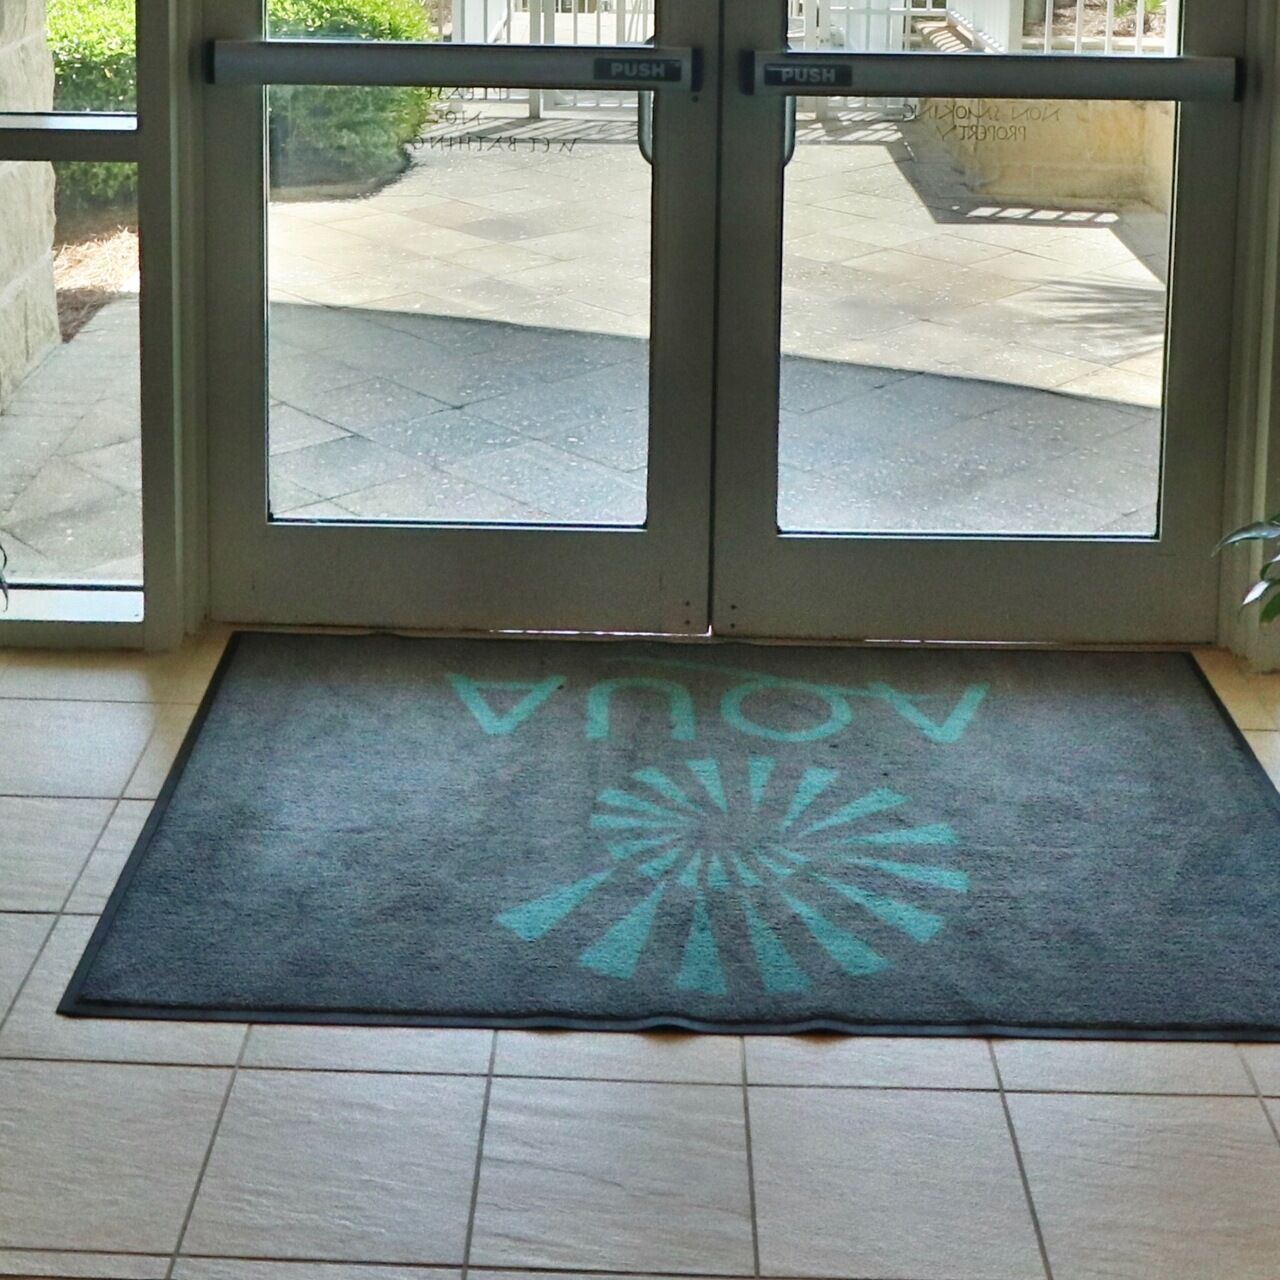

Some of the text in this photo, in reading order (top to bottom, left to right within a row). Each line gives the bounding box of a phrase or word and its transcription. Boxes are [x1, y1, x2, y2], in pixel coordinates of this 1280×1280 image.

[610, 62, 666, 78] PUSH
[780, 67, 836, 83] PUSH
[445, 657, 992, 742] AQUA
